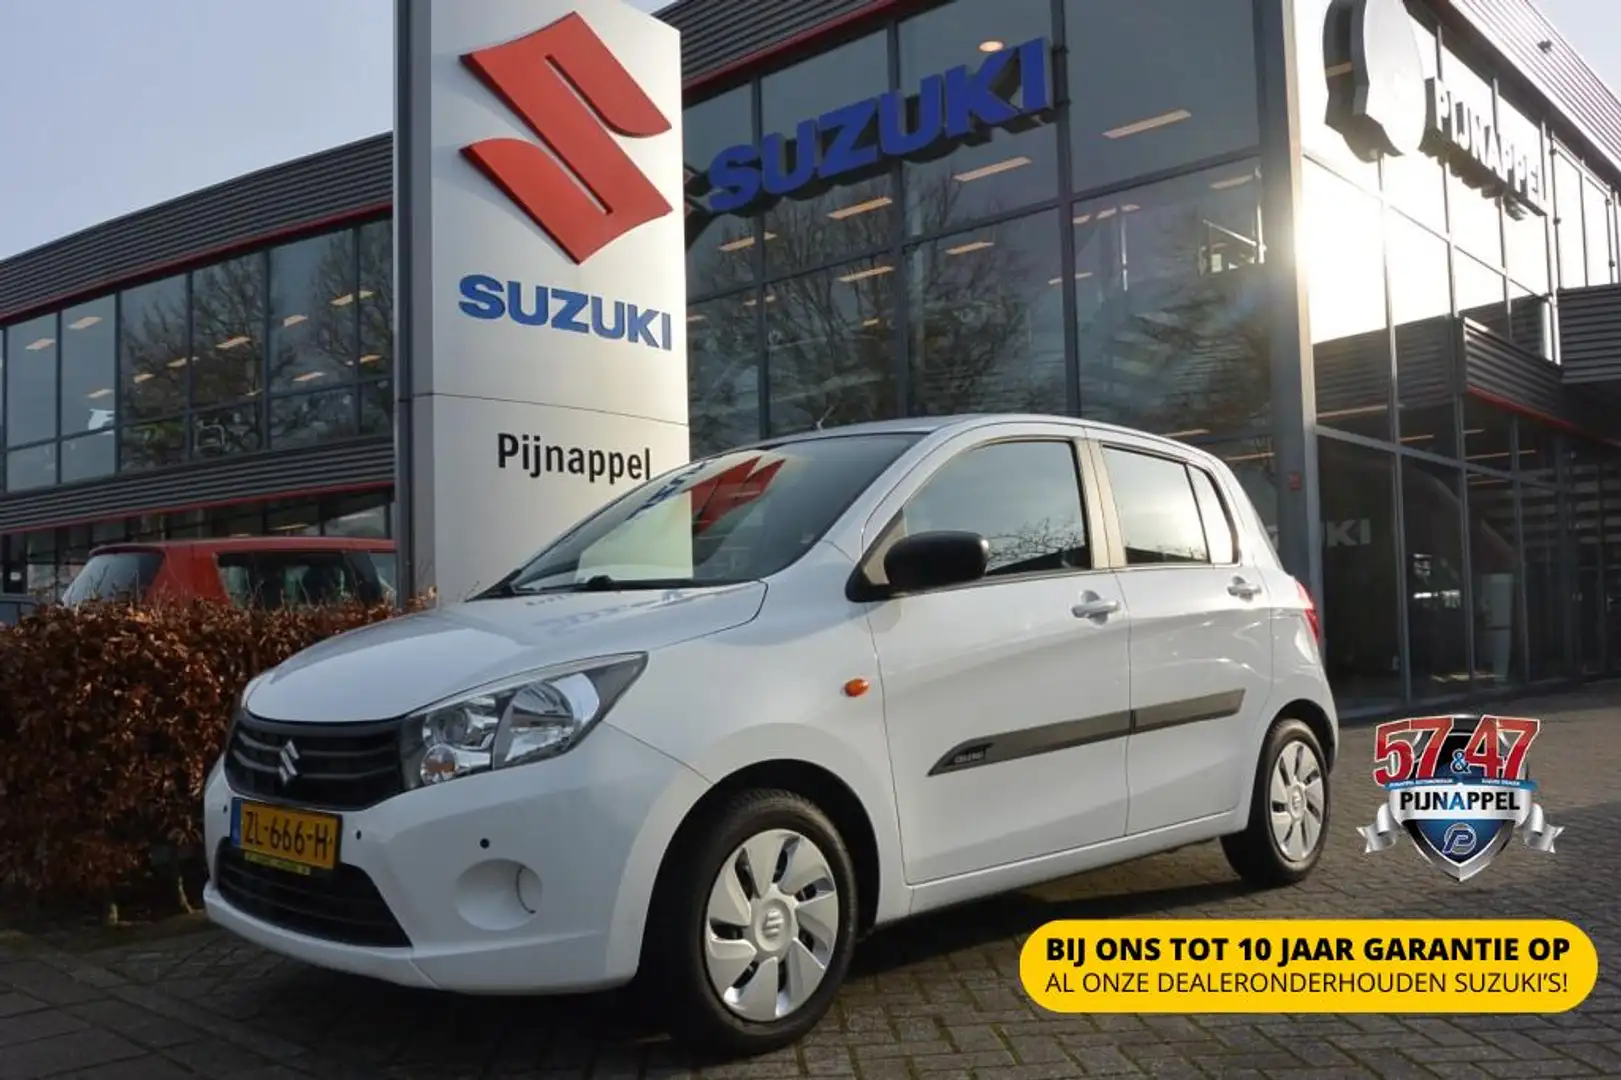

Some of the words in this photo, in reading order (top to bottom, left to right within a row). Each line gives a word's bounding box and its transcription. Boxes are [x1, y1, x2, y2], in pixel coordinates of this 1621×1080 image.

[708, 37, 1048, 213] SUZUKI
[458, 274, 672, 351] SUZUKI
[497, 433, 651, 485] Pijnappel
[244, 811, 329, 860] ZL-666-H
